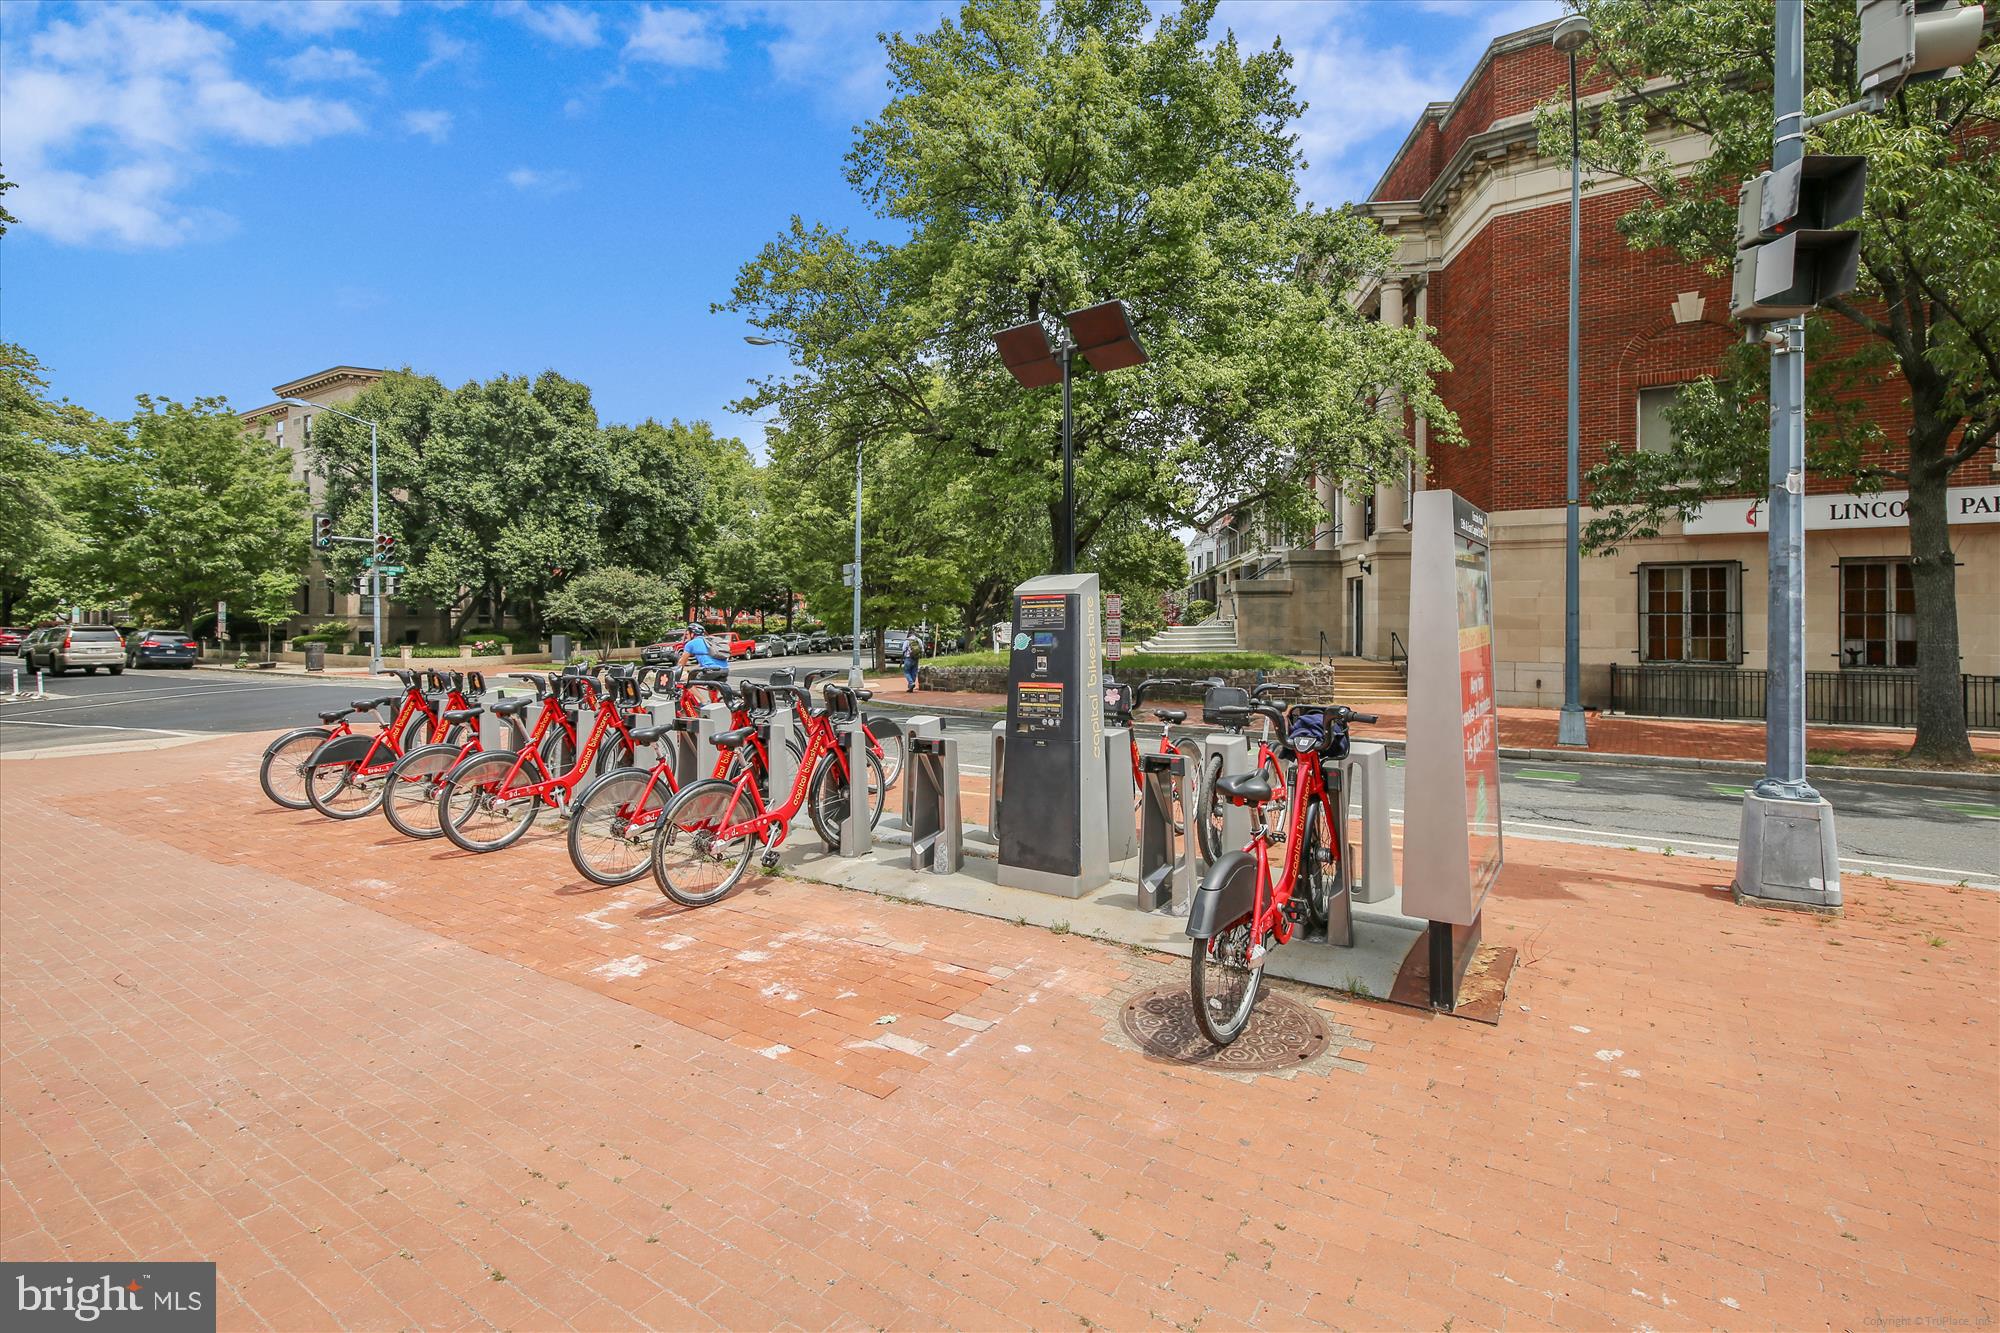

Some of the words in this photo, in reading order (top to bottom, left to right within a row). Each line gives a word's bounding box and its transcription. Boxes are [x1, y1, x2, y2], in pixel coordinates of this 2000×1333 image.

[1829, 500, 1907, 520] LINCO
[1086, 595, 1098, 688] bikeshare
[578, 747, 594, 774] capital
[588, 717, 608, 747] bikeshare
[1089, 693, 1101, 760] capital
[793, 776, 808, 806] capital
[805, 735, 822, 774] bikeshare
[1296, 776, 1312, 830] bikeshare
[1292, 833, 1302, 879] capital
